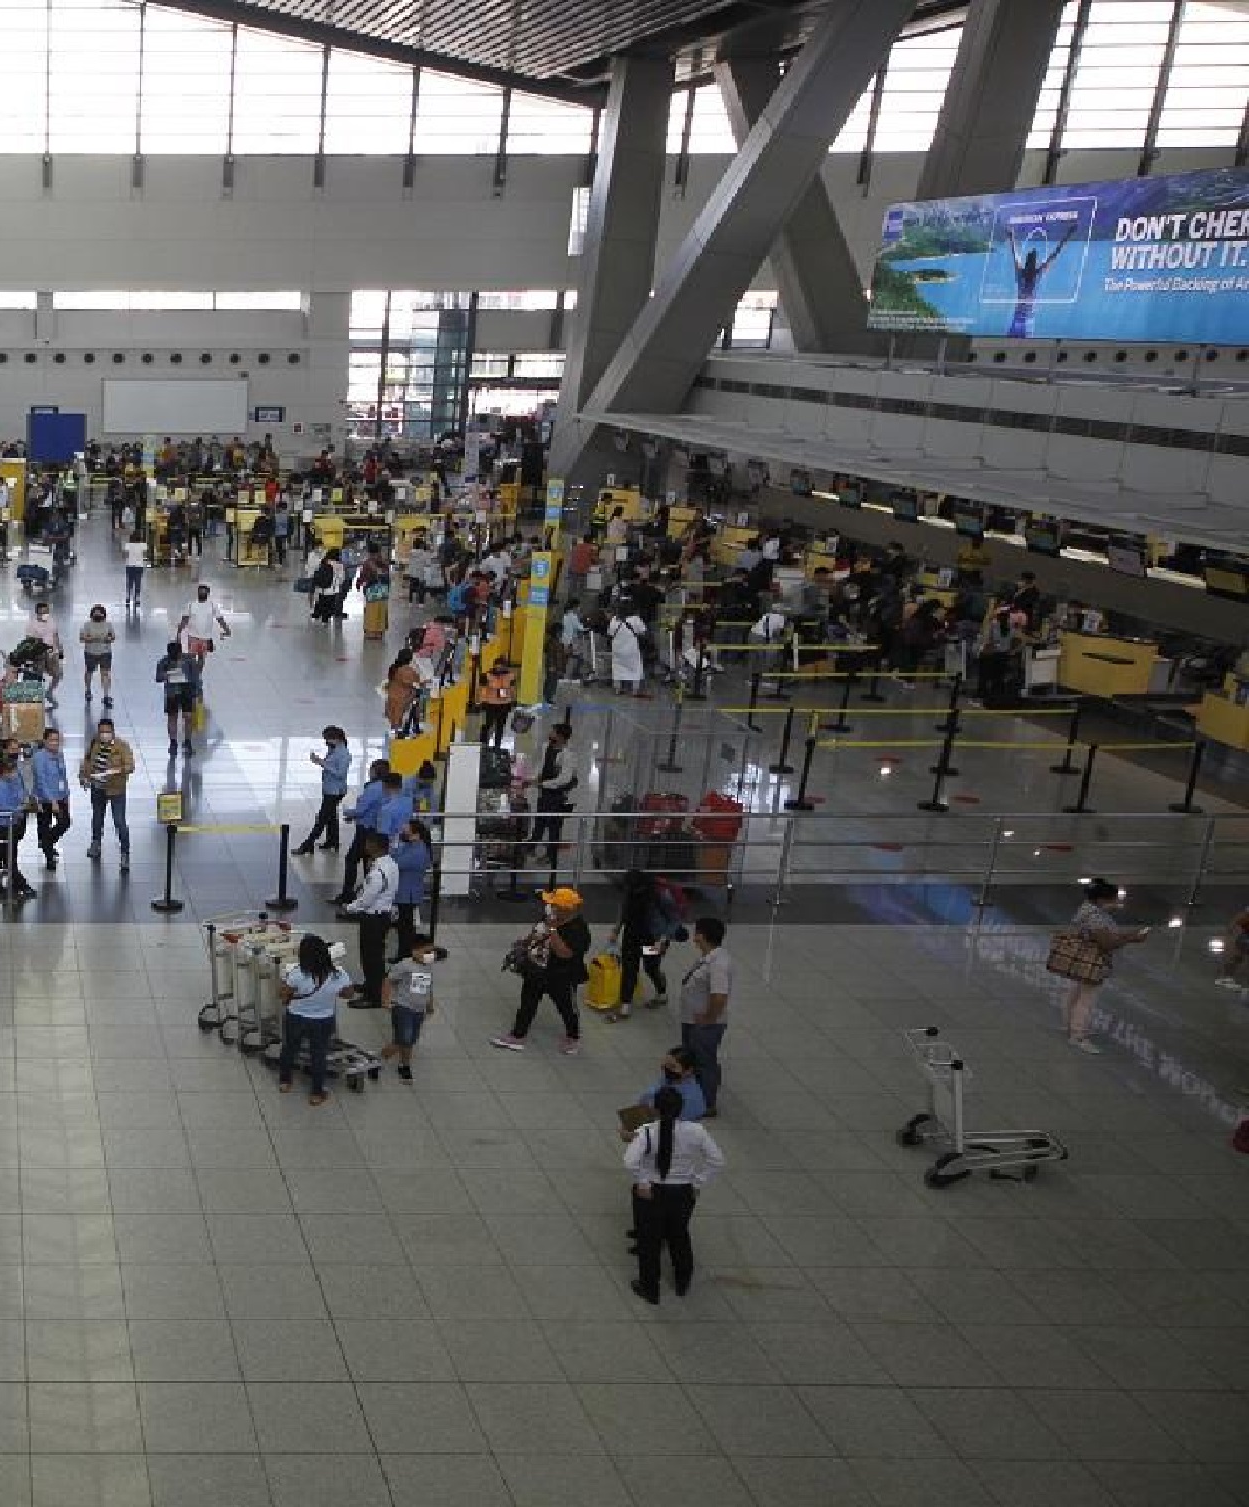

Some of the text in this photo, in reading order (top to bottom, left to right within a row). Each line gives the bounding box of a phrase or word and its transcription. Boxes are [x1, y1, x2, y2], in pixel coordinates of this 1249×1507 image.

[1116, 214, 1187, 241] DON'T
[1112, 240, 1248, 270] WITHOUT IT.
